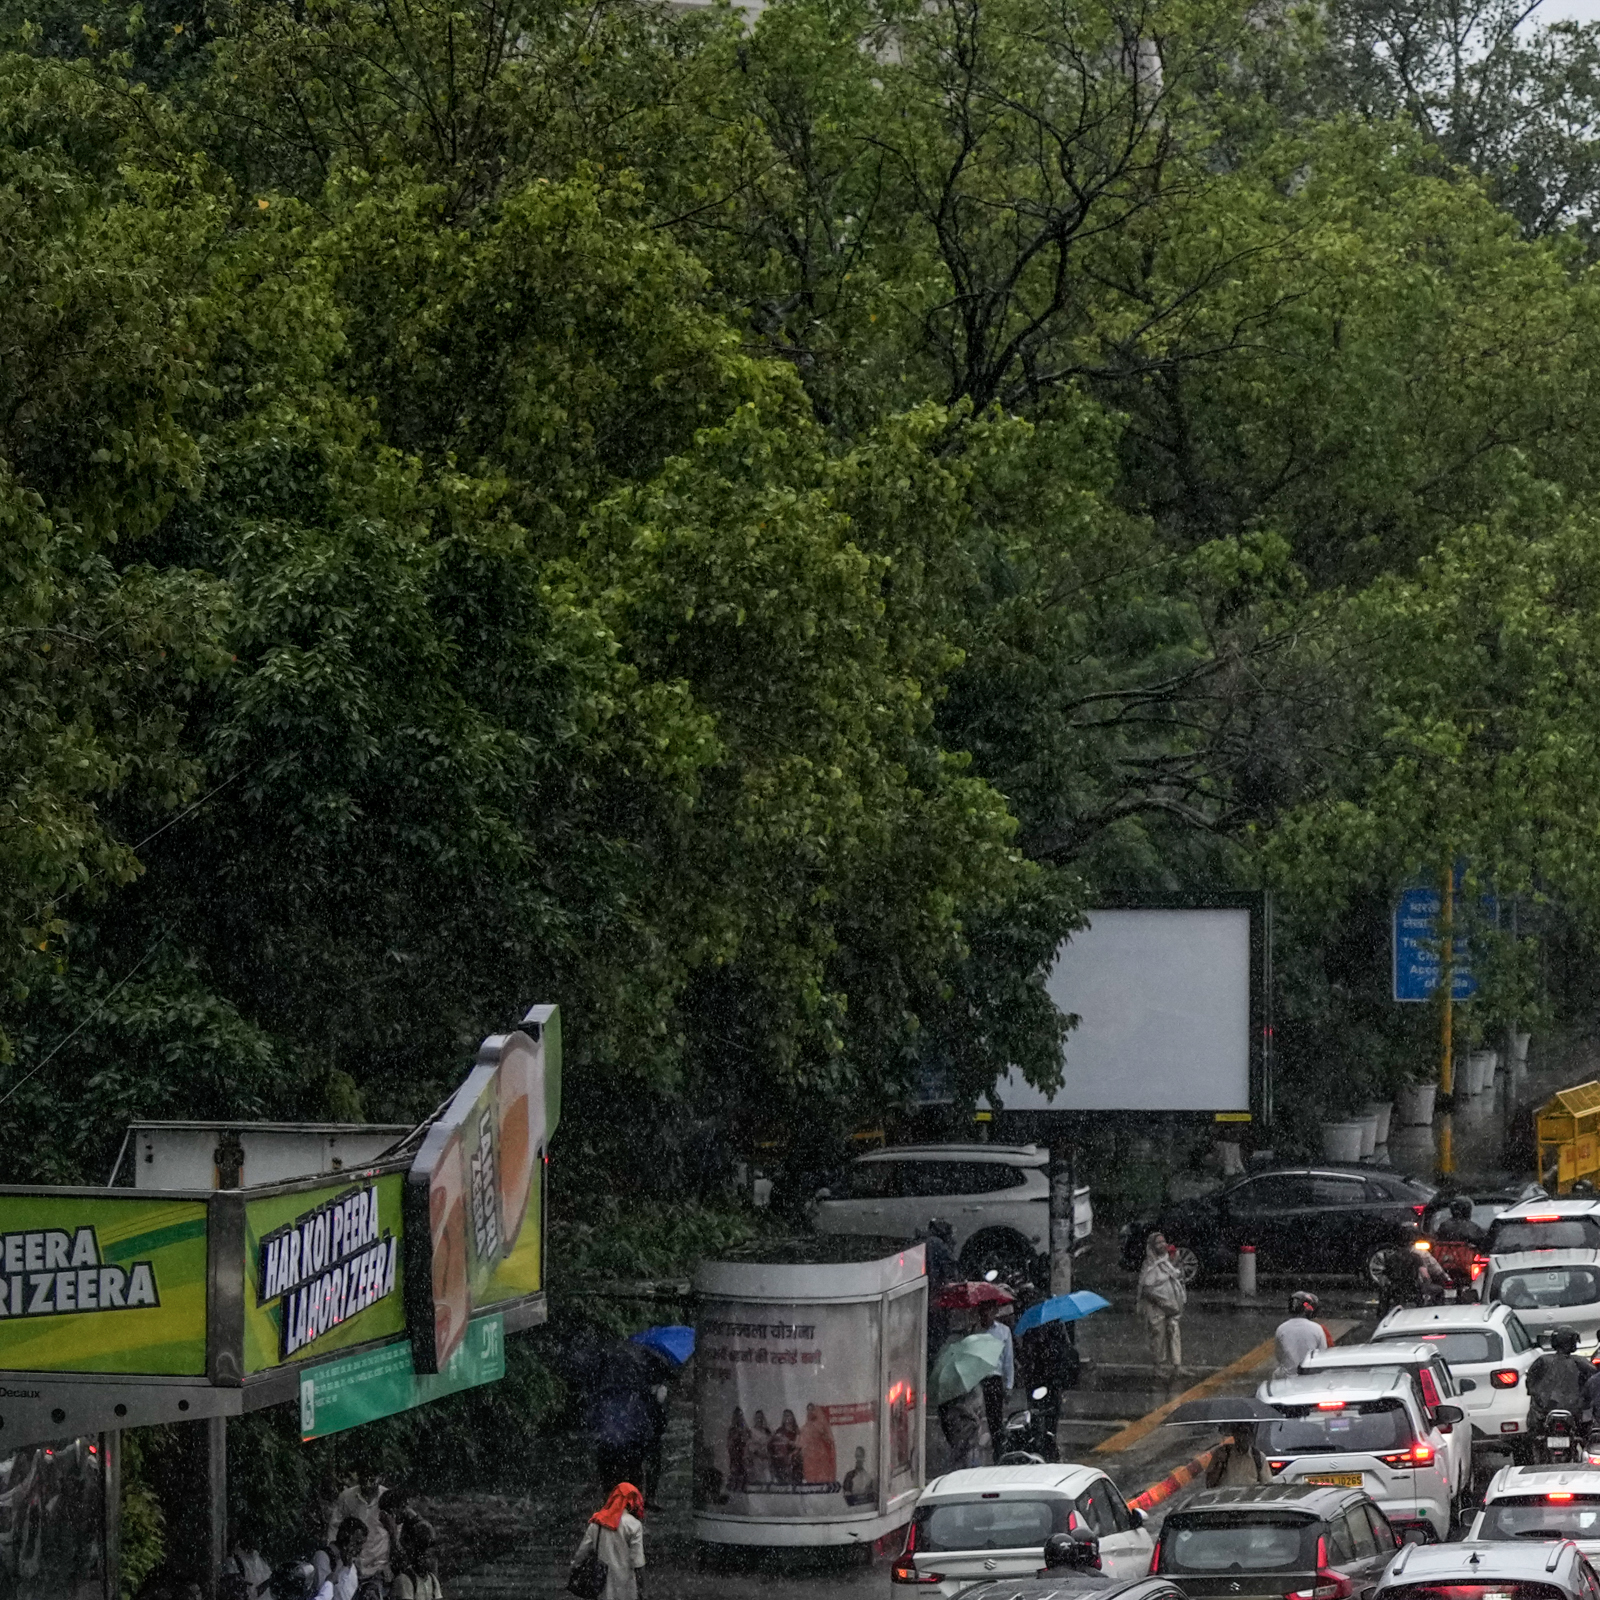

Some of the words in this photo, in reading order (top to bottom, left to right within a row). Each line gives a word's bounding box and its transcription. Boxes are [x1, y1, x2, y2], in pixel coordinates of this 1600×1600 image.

[0, 1230, 98, 1272] EERA
[264, 1237, 297, 1300] HAR
[297, 1207, 334, 1277] KOI
[333, 1186, 379, 1261] PEERA
[26, 1265, 156, 1315] ZEERA
[285, 1254, 344, 1355] LAHORI
[343, 1236, 398, 1311] ZEERA
